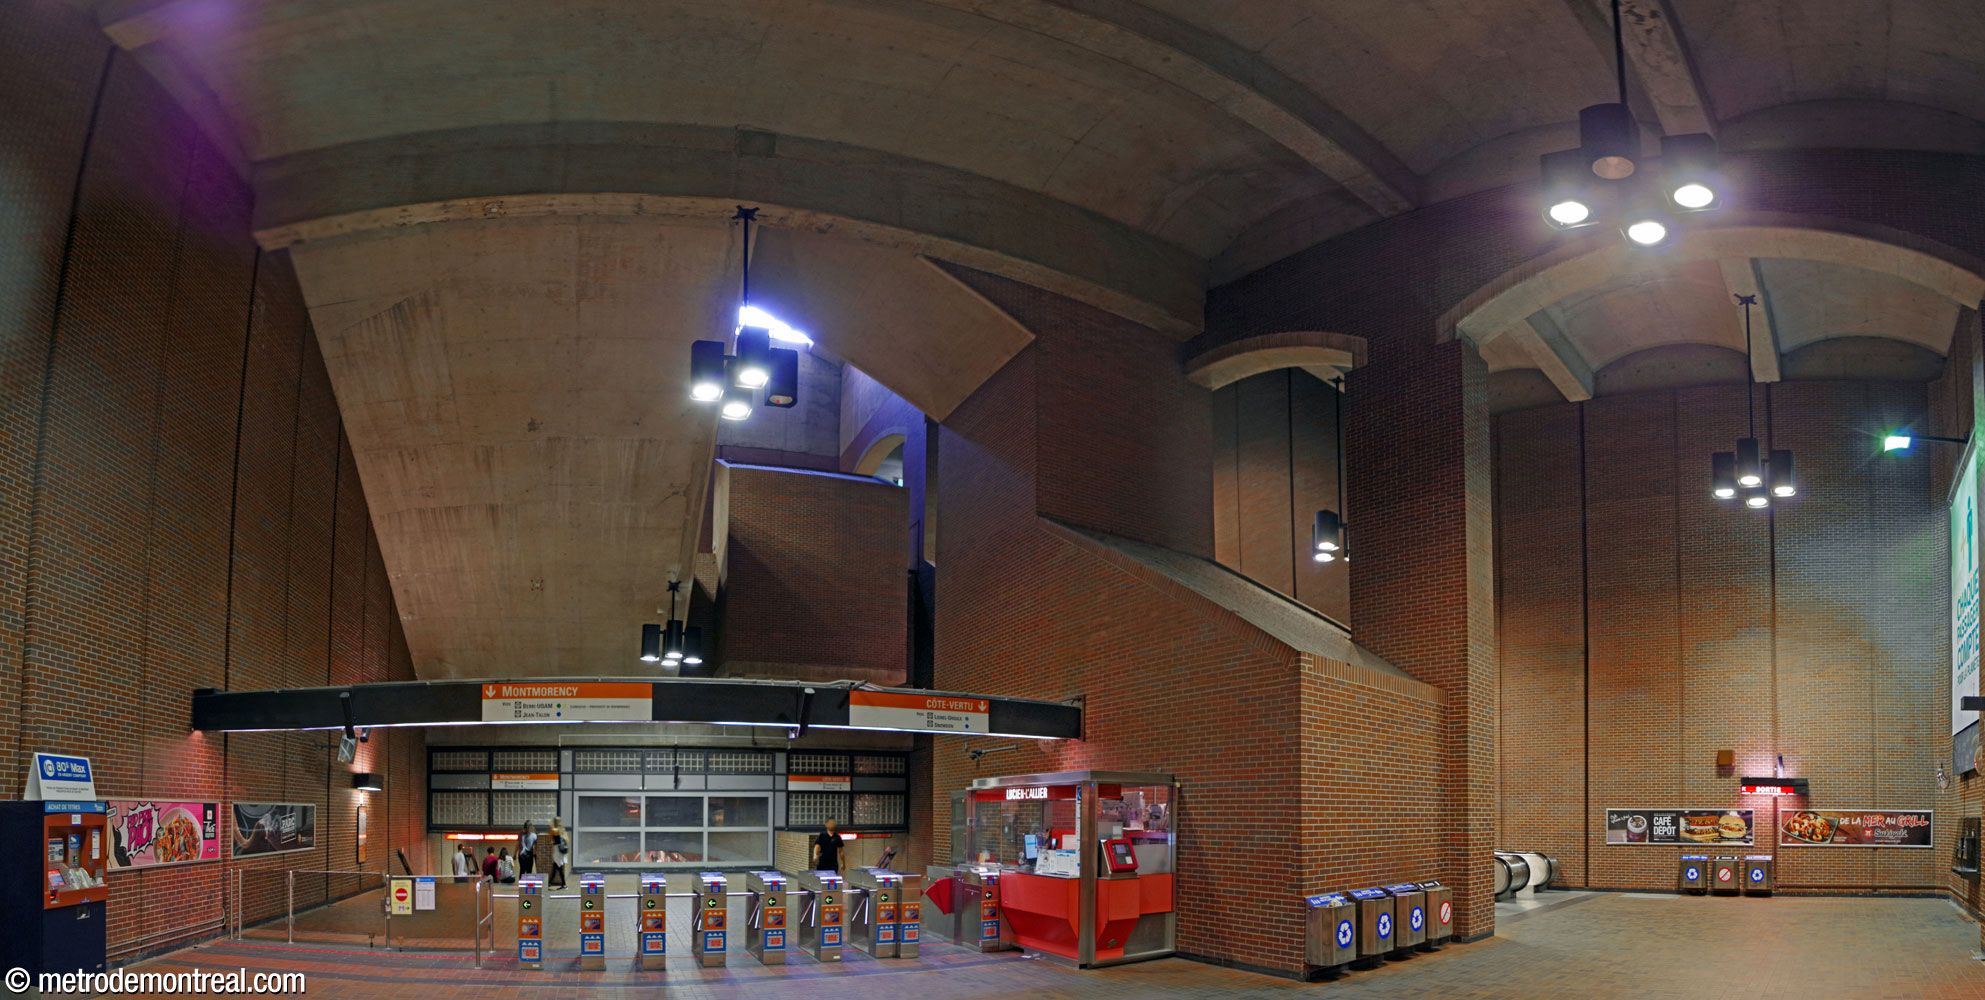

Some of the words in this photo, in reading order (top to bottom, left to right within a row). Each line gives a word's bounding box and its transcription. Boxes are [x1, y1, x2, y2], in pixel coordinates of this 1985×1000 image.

[1957, 567, 1979, 621] CHAQUE
[1957, 623, 1979, 670] COMPTE
[502, 686, 578, 697] MONTMORENCY
[926, 698, 973, 711] CÔTE-VERTU
[70, 762, 86, 774] Max
[1006, 787, 1048, 800] LUCIEN-L'ALLIER
[1653, 816, 1672, 826] CAFÉ
[1839, 817, 1850, 825] DE
[1851, 817, 1861, 825] LA
[1863, 815, 1885, 828] MER
[1885, 817, 1896, 825] AU
[1897, 815, 1929, 828] GRILL
[1653, 826, 1677, 835] DÉPÔT
